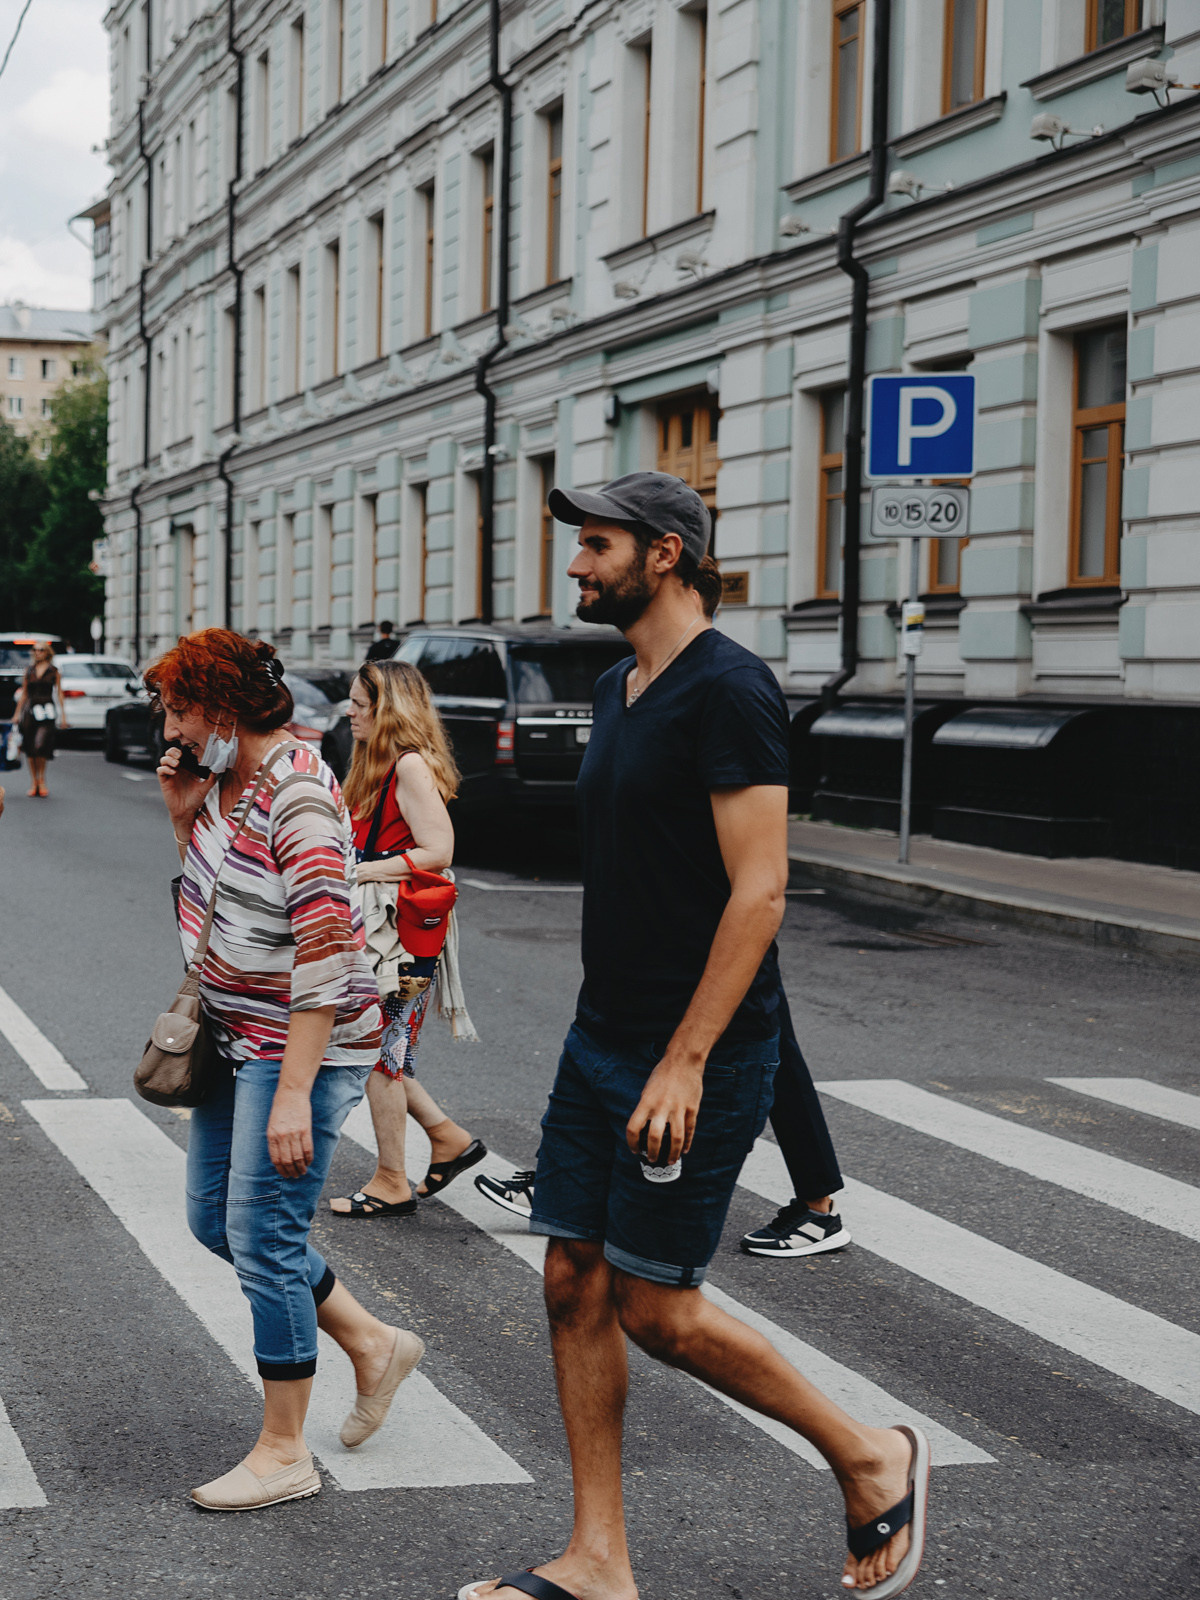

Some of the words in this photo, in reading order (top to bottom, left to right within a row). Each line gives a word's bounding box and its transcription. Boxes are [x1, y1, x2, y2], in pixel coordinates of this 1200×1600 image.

[897, 386, 957, 466] P
[885, 504, 899, 519] 10
[905, 503, 922, 521] 15
[930, 502, 958, 523] 20
